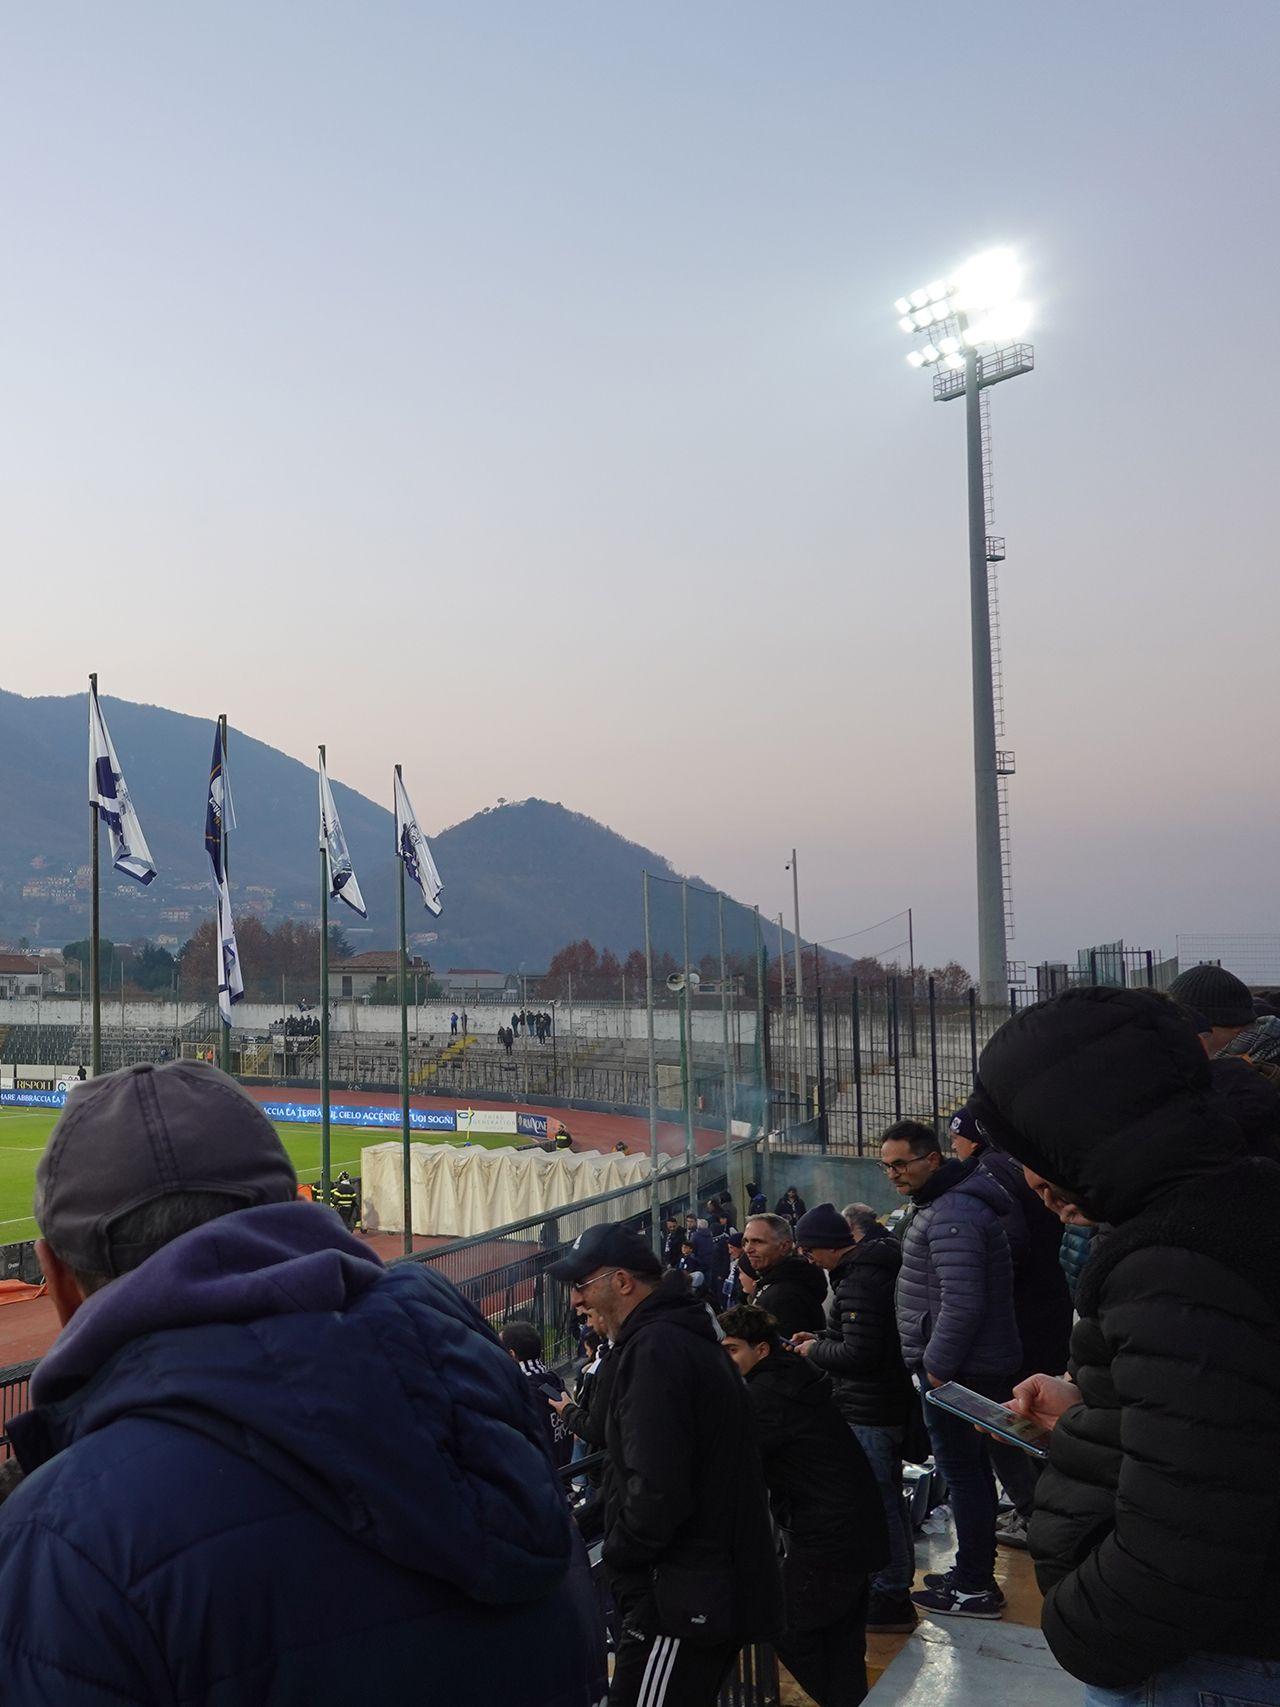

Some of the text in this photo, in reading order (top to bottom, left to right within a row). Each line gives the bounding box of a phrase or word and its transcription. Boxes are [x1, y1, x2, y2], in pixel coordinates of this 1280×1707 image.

[17, 1094, 51, 1103] ABBRACCIA
[339, 1110, 361, 1120] CIELO
[361, 1111, 401, 1122] ACCENDE
[427, 1114, 454, 1125] SOGNI
